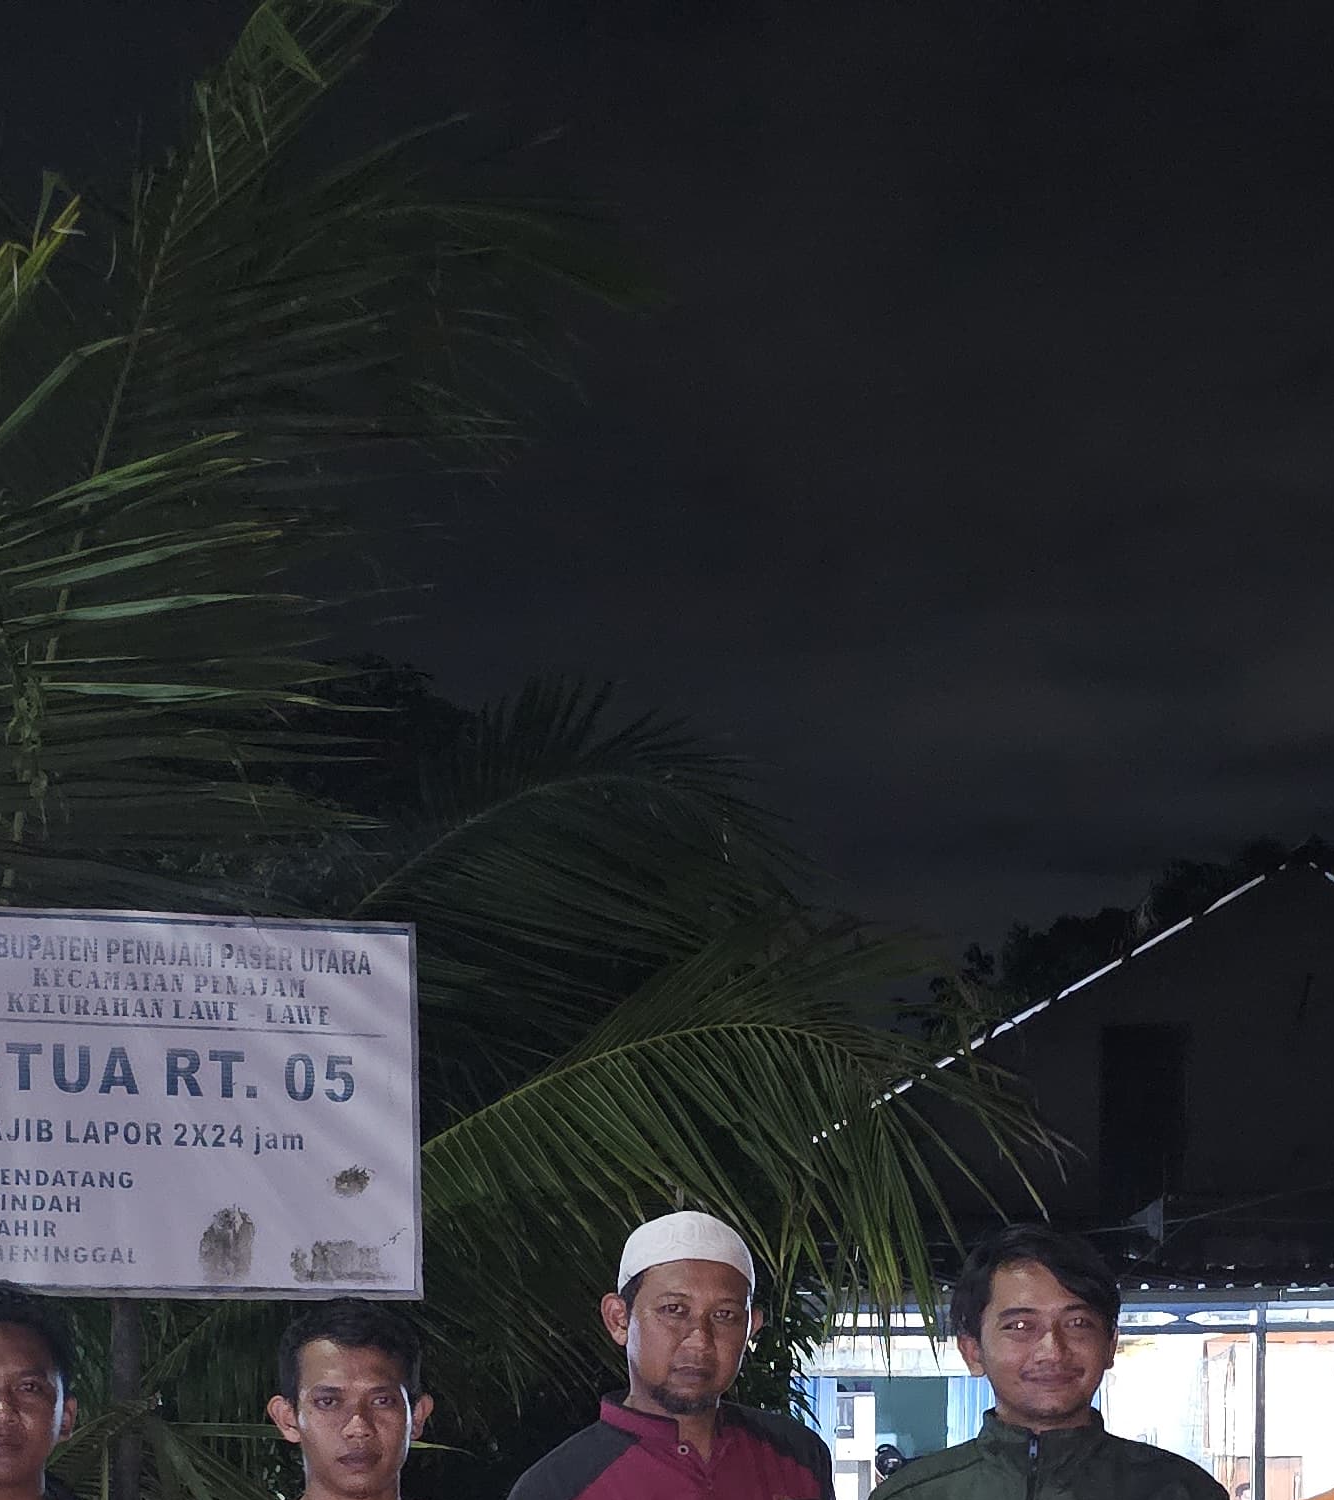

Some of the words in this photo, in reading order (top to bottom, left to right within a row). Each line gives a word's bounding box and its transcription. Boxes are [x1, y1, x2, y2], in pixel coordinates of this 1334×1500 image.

[106, 938, 213, 968] PENAJAM
[220, 942, 292, 973] PASER
[300, 947, 372, 976] UTARA
[33, 966, 183, 993] KECAMATAN
[195, 973, 307, 999] PENAJAM
[7, 992, 164, 1020] KELURAHAN
[173, 997, 238, 1022] LAWE
[266, 1001, 331, 1026] LAWE
[166, 1049, 258, 1099] RT.
[284, 1053, 356, 1103] 05
[66, 1121, 162, 1147] LAPOR
[174, 1123, 244, 1149] 2X24
[253, 1127, 304, 1156] jam
